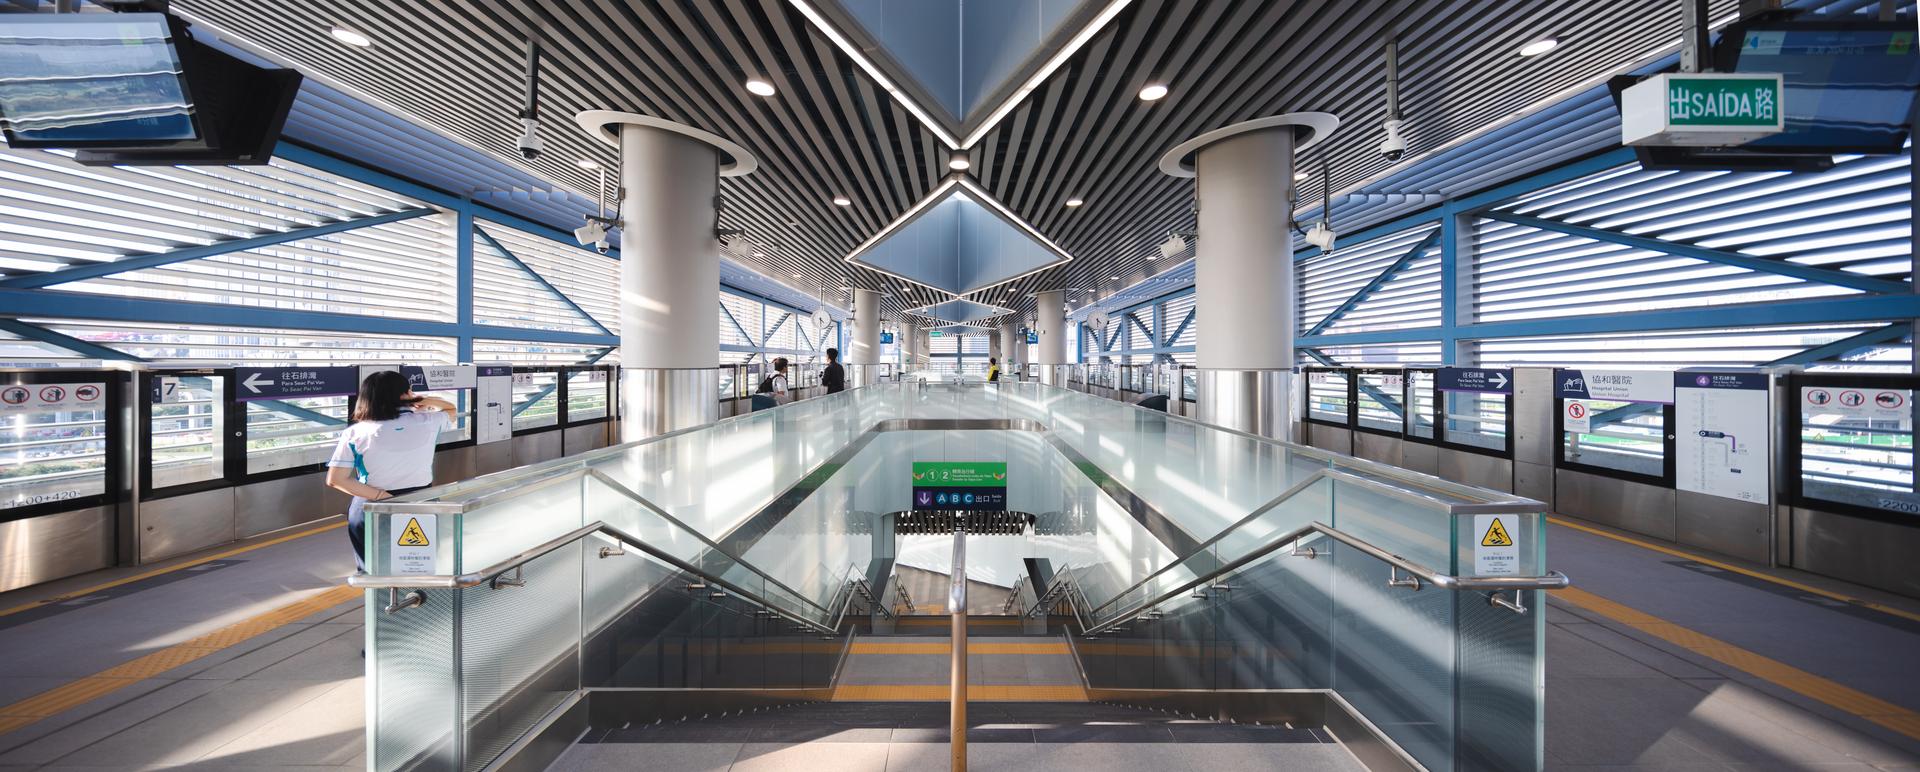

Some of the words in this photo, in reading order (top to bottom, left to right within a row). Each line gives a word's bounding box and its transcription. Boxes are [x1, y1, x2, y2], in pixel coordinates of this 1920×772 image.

[1592, 375, 1633, 385] 協和醫院
[153, 388, 159, 396] 1
[164, 382, 176, 396] 7
[943, 471, 949, 480] 2
[938, 494, 946, 503] A
[952, 494, 959, 503] B
[964, 494, 972, 503] C
[975, 494, 990, 503] 出口
